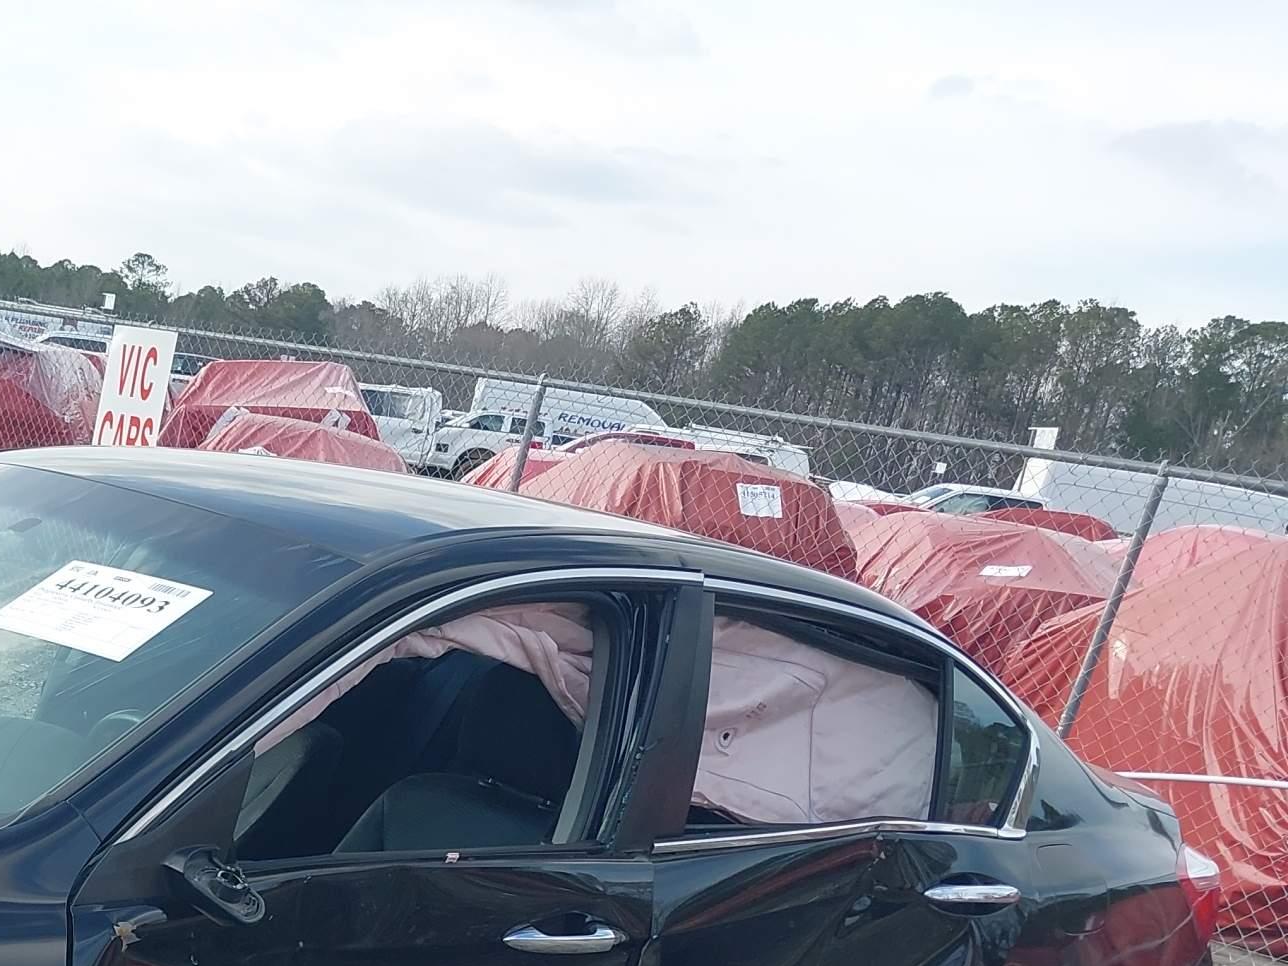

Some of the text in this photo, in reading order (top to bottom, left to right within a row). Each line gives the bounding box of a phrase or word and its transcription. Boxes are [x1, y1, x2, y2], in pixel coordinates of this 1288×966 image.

[118, 344, 158, 401] VIC
[97, 410, 154, 446] CARS
[55, 578, 171, 614] 44104093
